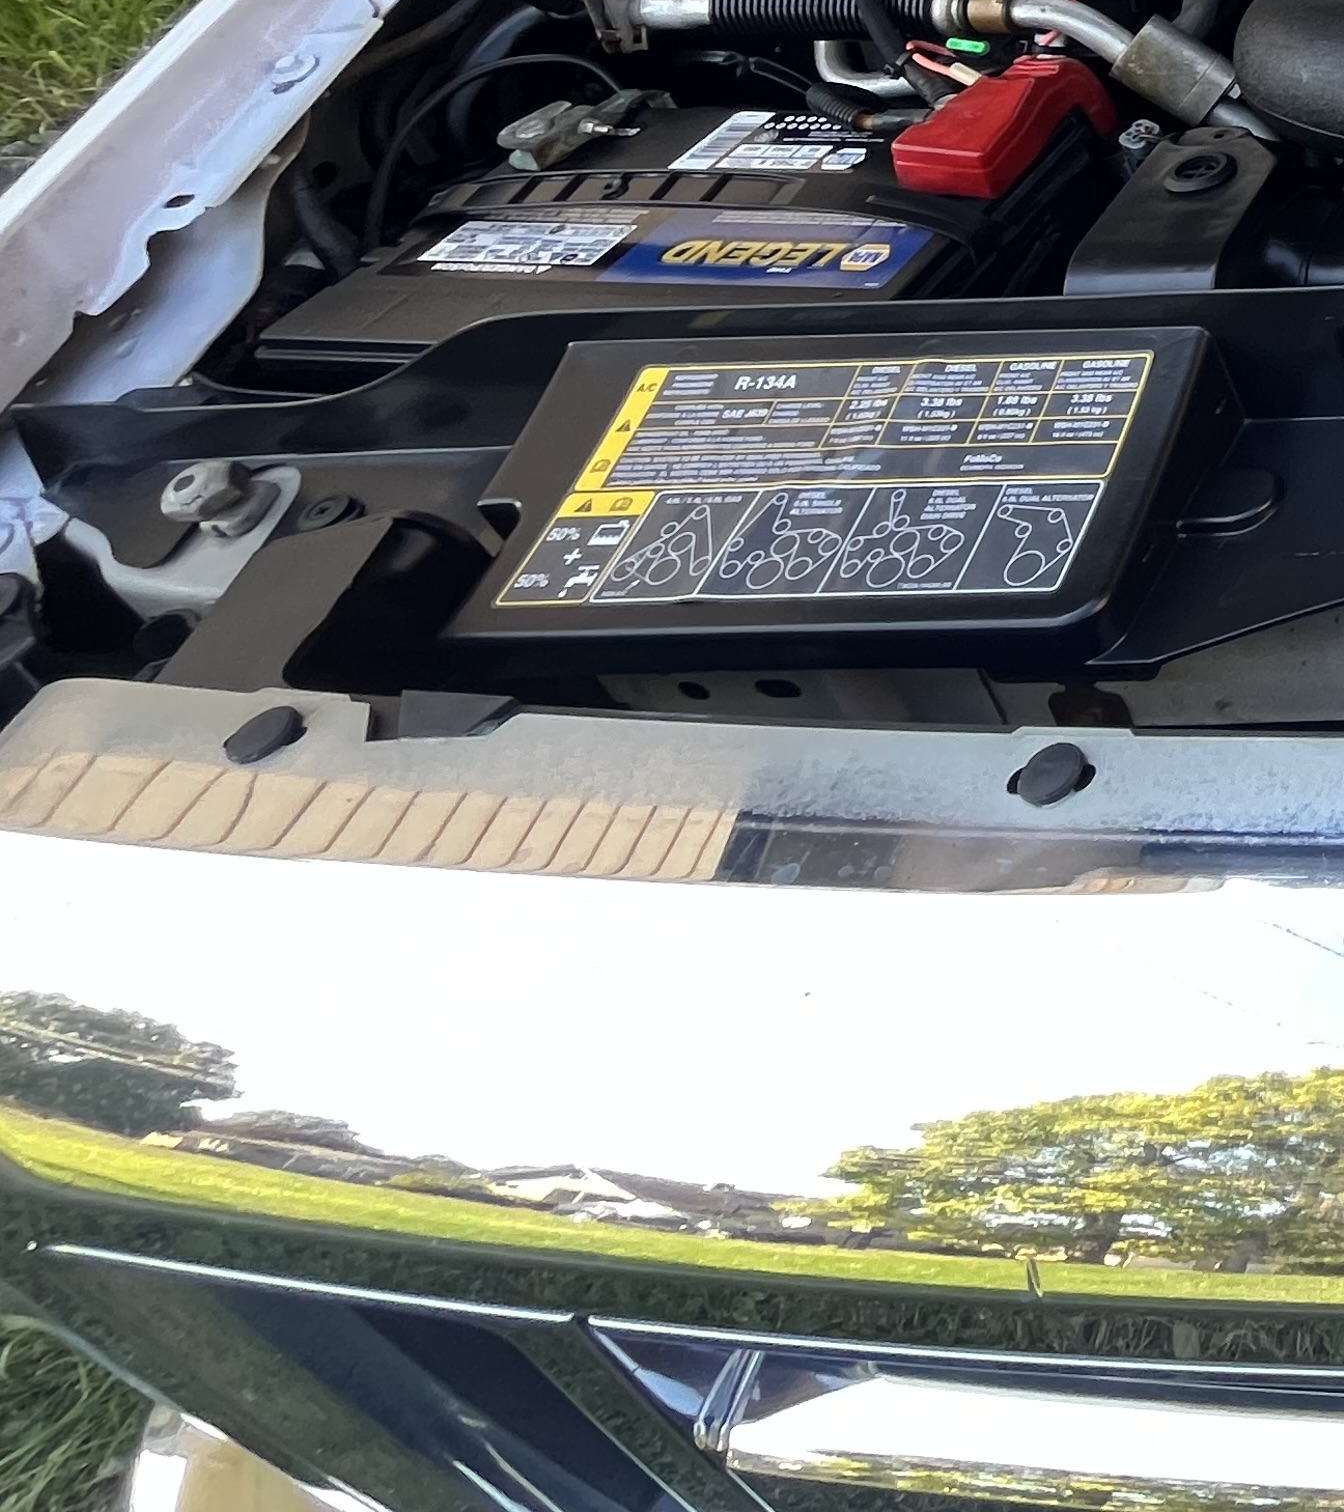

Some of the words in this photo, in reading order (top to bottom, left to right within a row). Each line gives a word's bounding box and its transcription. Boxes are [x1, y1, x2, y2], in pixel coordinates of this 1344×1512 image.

[661, 240, 849, 268] LEGEND
[847, 251, 884, 264] NAPA
[944, 364, 977, 373] DIESEL
[1009, 361, 1058, 371] GASOLINE
[1082, 359, 1131, 369] GASOLINE
[636, 382, 658, 393] A/C
[734, 374, 798, 391] R-134A
[945, 397, 964, 407] lbs
[1020, 396, 1039, 405] lbs
[1094, 393, 1114, 404] lbs
[721, 409, 745, 419] SAE
[1041, 494, 1095, 502] ALTERNATOR
[546, 527, 582, 542] 50%
[514, 573, 550, 588] 50%
